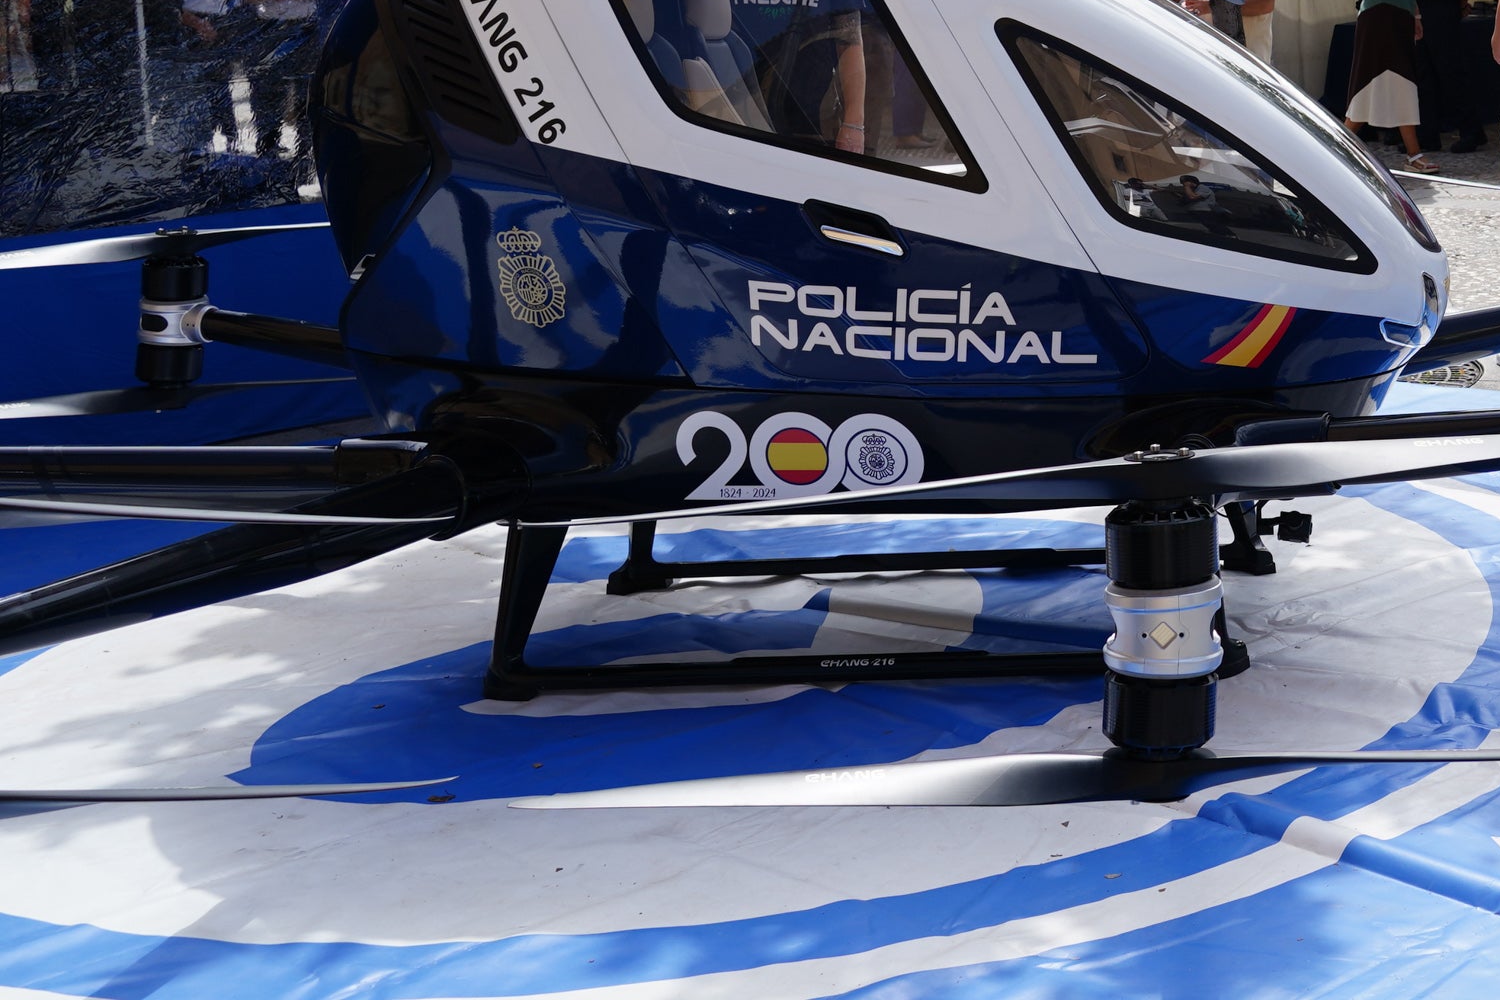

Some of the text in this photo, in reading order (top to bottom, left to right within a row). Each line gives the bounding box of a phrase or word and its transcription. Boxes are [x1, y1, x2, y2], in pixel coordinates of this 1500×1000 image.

[514, 77, 567, 145] 216
[748, 280, 1016, 326] POLICÍA
[750, 315, 1098, 364] NACIONAL
[676, 410, 925, 500] 200
[720, 488, 742, 498] 1824
[753, 488, 776, 498] 2024
[872, 658, 896, 666] 216
